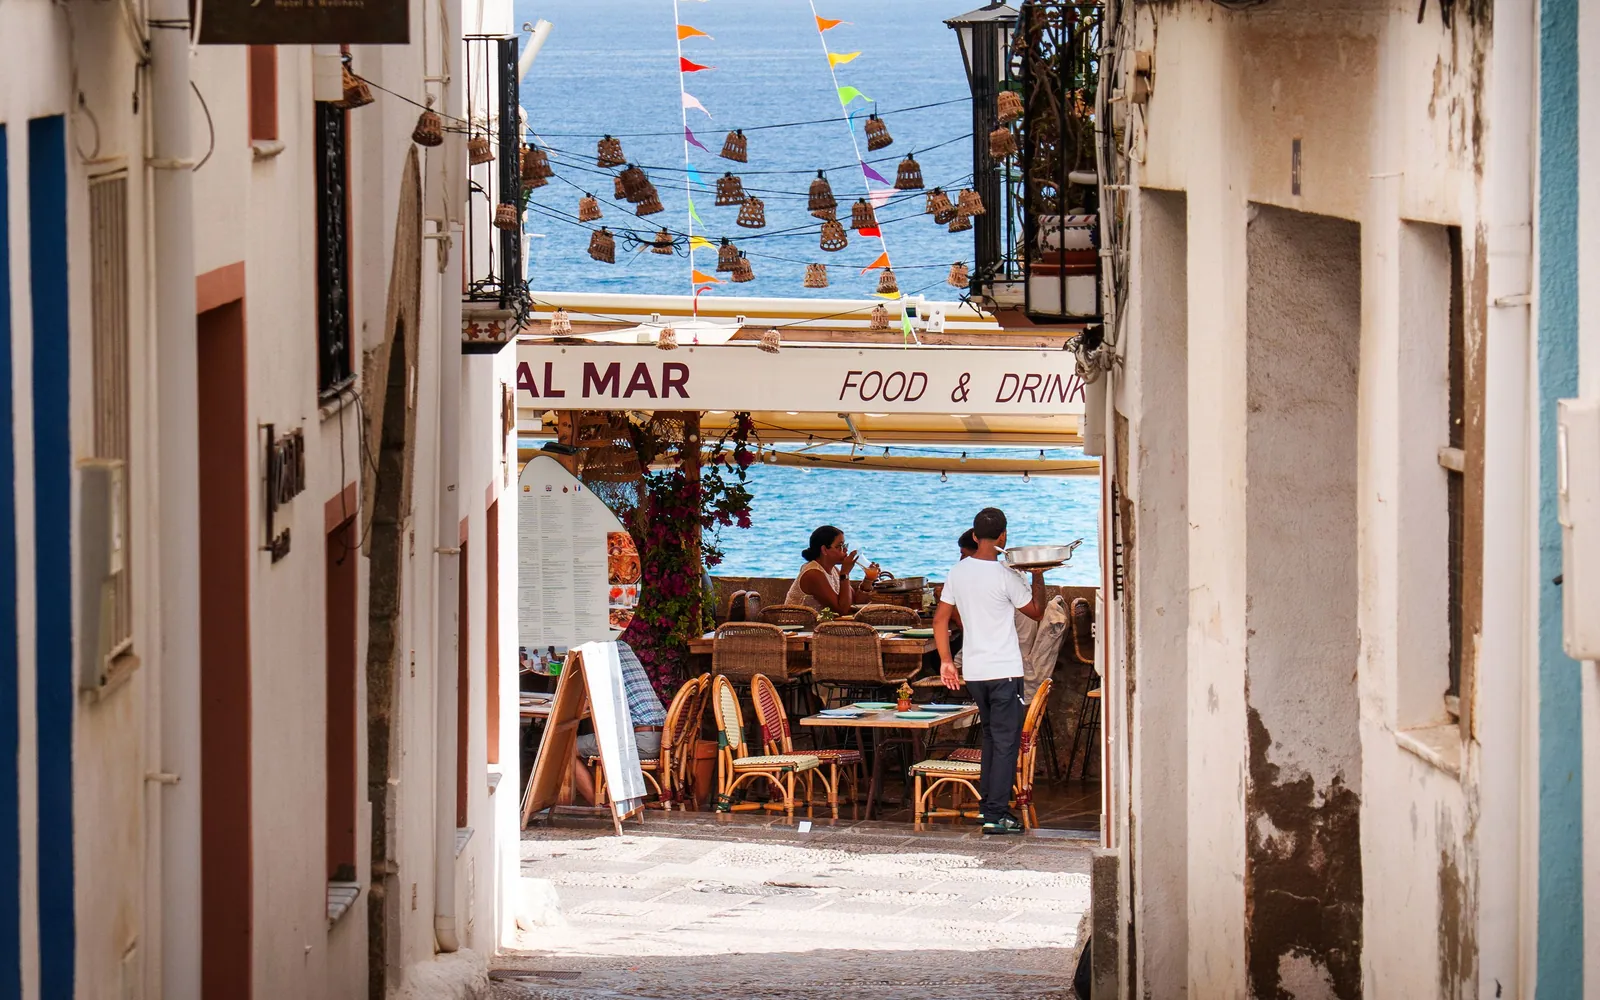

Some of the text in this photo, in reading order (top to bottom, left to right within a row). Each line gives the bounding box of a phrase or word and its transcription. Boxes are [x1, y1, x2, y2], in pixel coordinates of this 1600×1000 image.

[516, 361, 691, 399] AL MAR
[839, 370, 1086, 403] FOOD & DRINK
